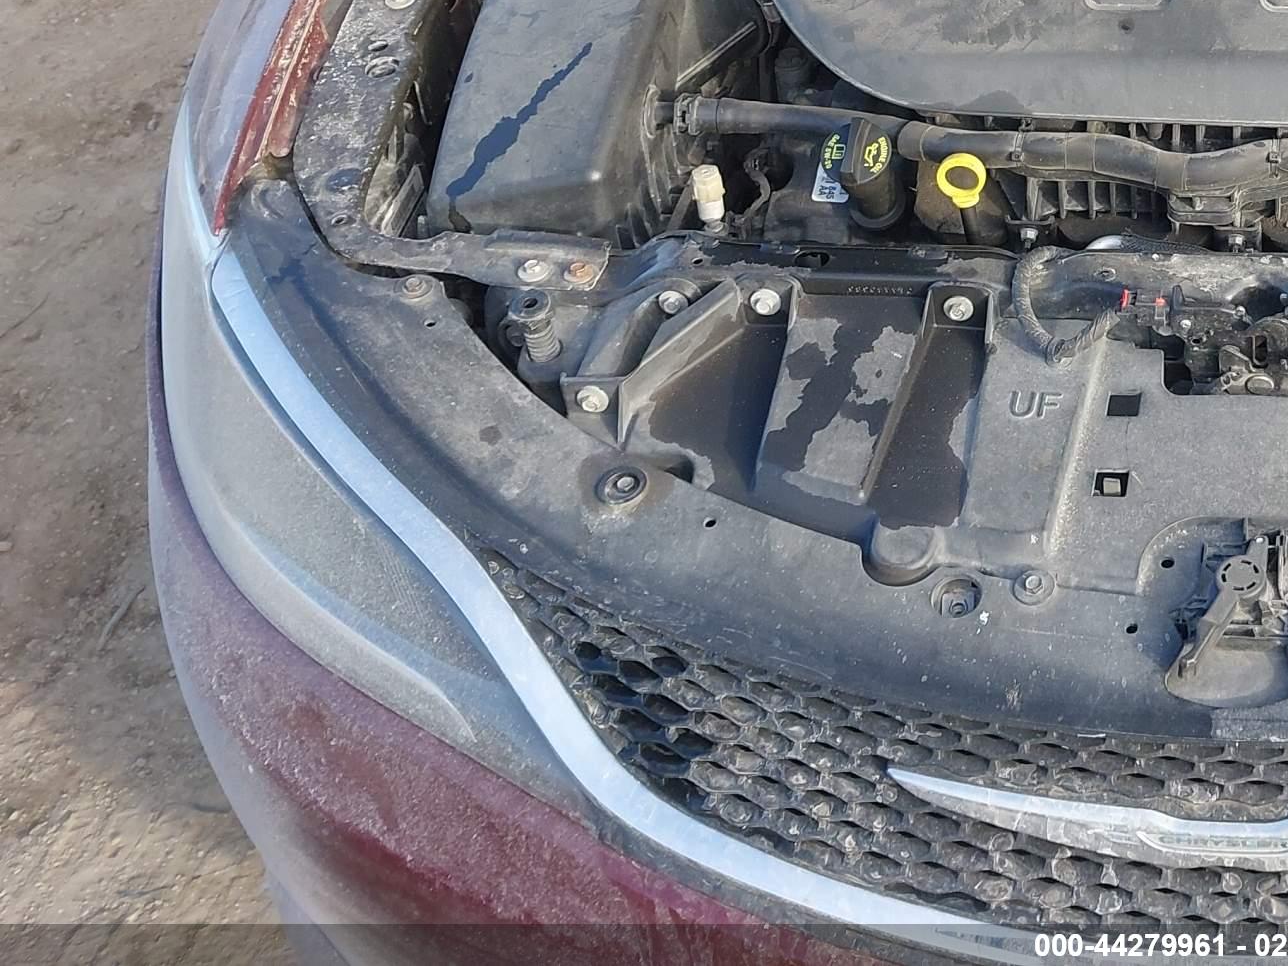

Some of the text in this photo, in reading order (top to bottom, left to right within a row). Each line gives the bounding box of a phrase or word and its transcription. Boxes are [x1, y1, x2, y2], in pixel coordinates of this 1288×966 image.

[869, 136, 889, 174] ENGINE OIL
[1009, 390, 1064, 419] UF
